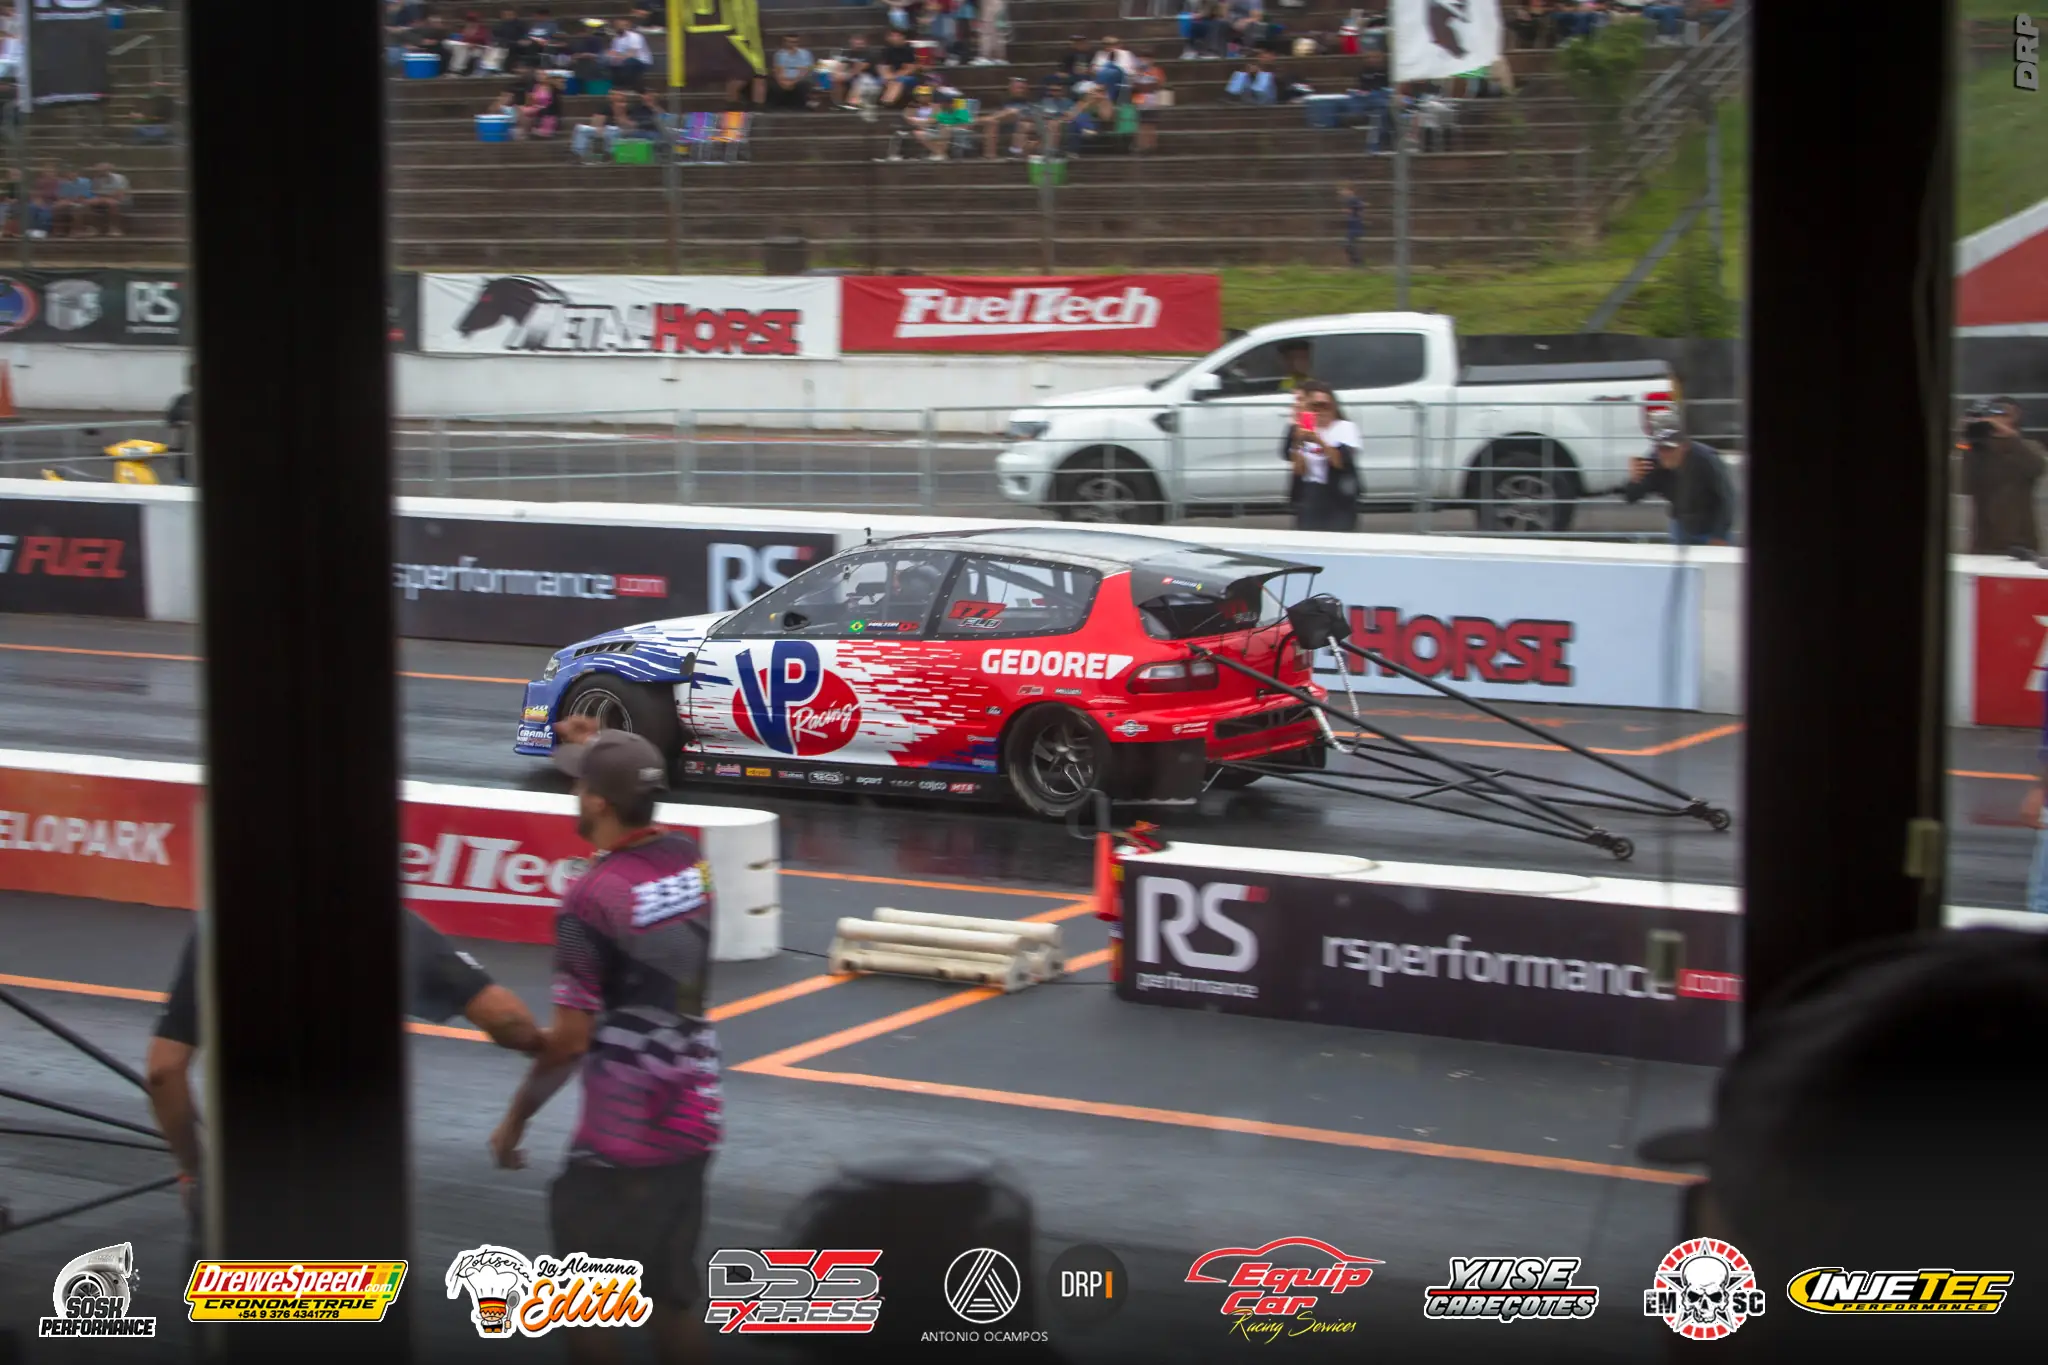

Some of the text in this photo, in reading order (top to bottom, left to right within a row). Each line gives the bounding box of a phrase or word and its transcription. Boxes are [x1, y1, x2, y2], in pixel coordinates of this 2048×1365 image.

[897, 286, 1162, 329] FuelTech
[981, 648, 1106, 680] GEDORE
[735, 640, 821, 755] VP
[792, 700, 861, 742] Racing
[1136, 875, 1269, 972] RS
